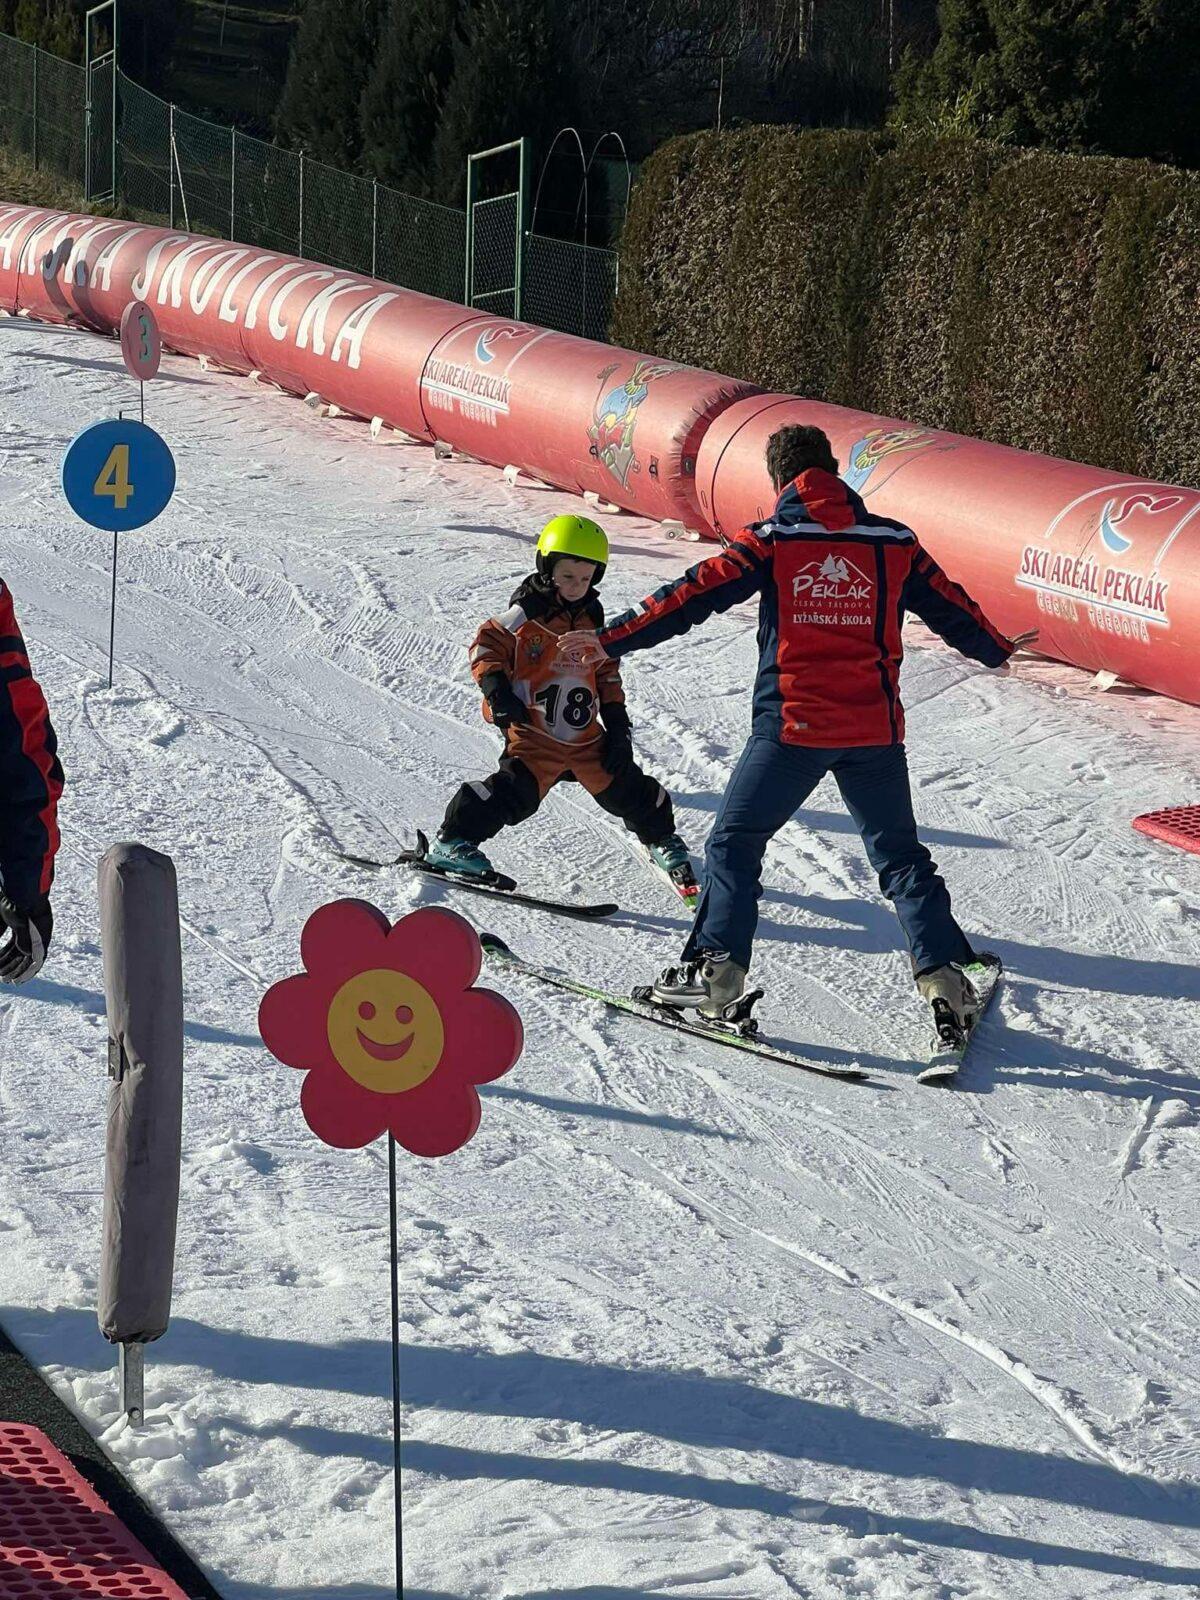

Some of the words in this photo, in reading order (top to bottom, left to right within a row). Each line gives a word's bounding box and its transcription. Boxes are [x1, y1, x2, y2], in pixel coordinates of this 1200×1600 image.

[94, 444, 134, 508] 4
[1022, 546, 1050, 579] SKI
[1051, 554, 1099, 594] AREÁL
[1103, 568, 1169, 613] PEKLÁK
[841, 614, 871, 625] ŠKOLA
[534, 684, 594, 730] 18
